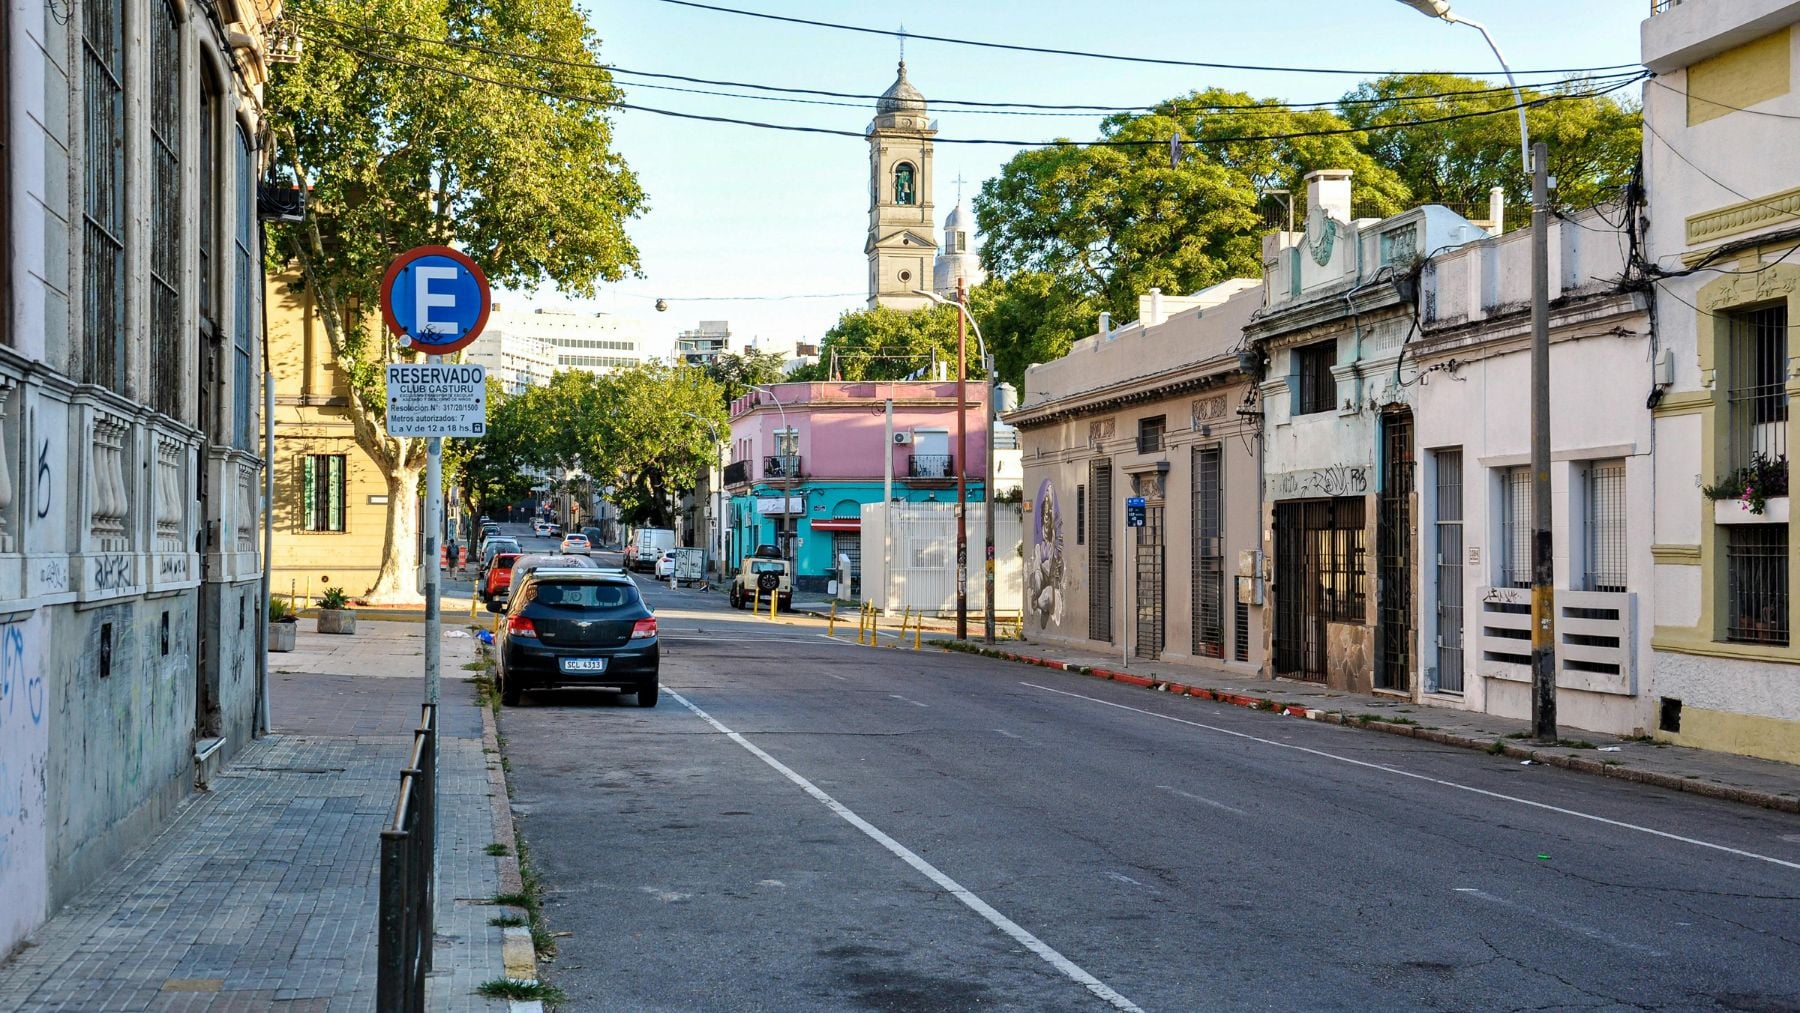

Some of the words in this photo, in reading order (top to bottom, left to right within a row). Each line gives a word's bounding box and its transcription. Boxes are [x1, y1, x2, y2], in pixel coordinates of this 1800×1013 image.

[415, 266, 459, 335] E
[390, 368, 482, 384] RESERVADO
[400, 385, 426, 393] CLUB
[428, 385, 474, 393] CASTURU
